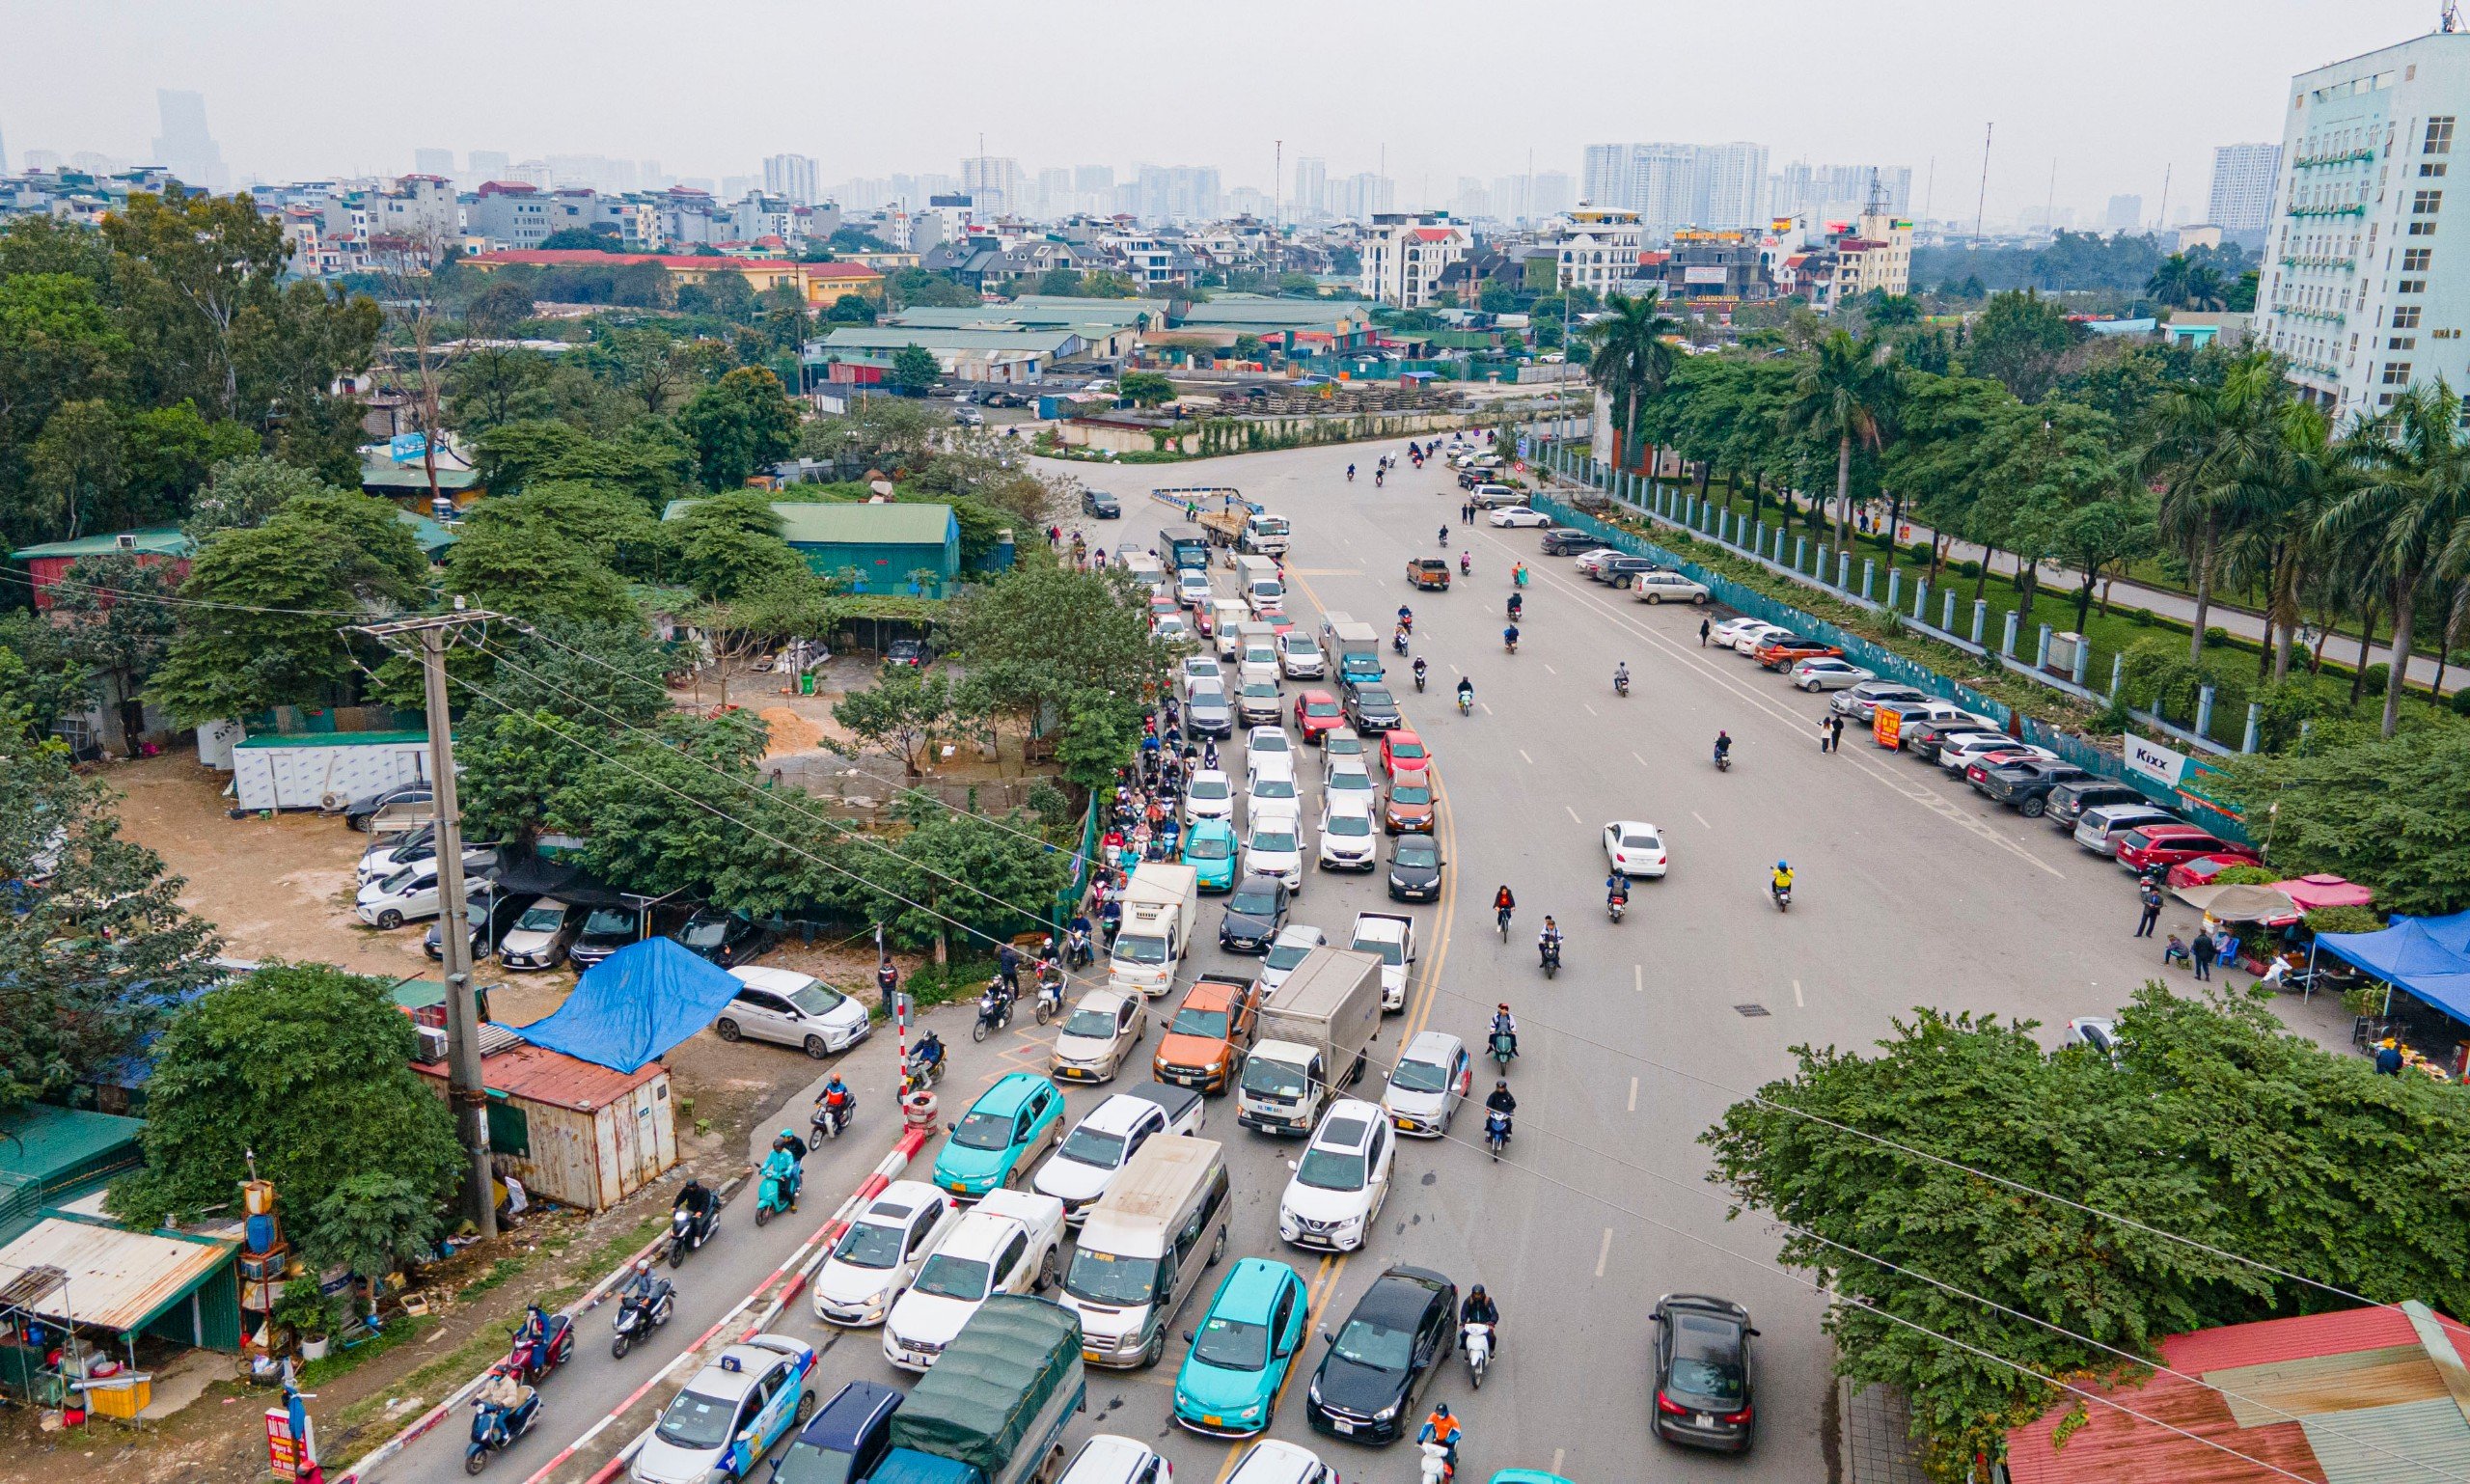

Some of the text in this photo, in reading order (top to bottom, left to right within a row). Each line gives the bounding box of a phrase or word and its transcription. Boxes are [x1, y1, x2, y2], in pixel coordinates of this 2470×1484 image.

[2431, 327, 2461, 339] NHÀ B
[2136, 748, 2168, 770] Kixx
